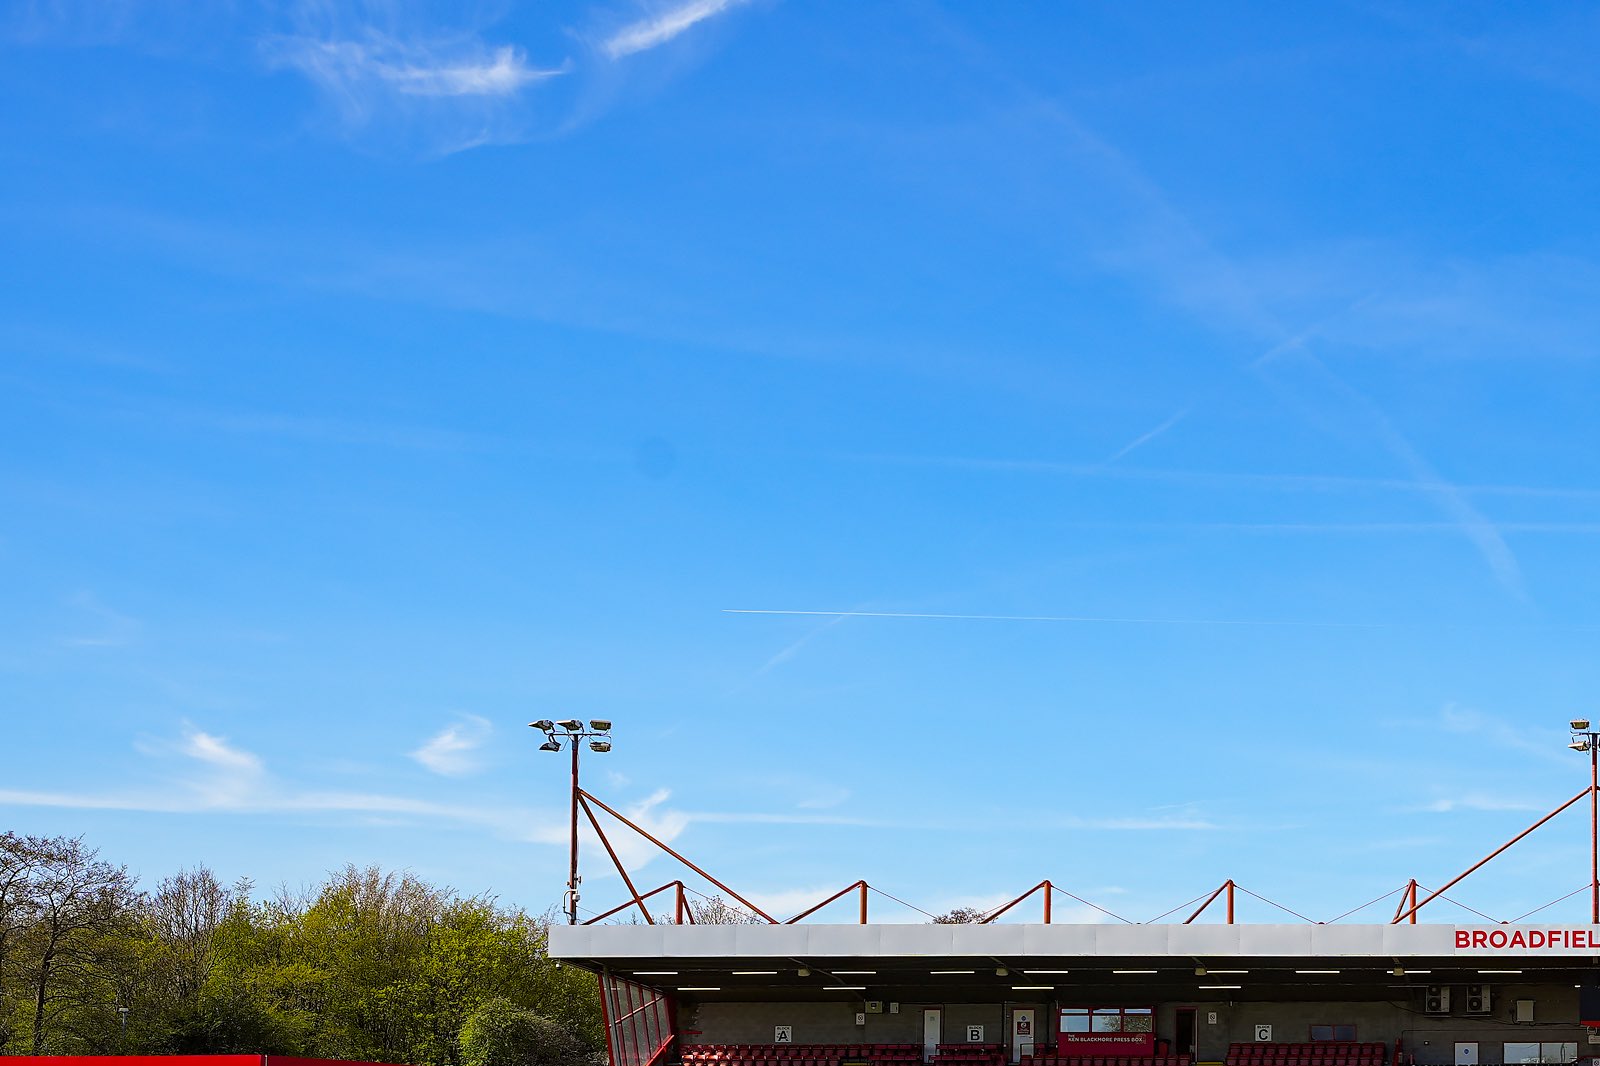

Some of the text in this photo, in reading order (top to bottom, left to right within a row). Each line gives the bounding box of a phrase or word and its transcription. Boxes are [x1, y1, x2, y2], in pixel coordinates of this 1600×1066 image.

[778, 1030, 789, 1042] A
[970, 1030, 980, 1041] B
[1258, 1029, 1269, 1041] C
